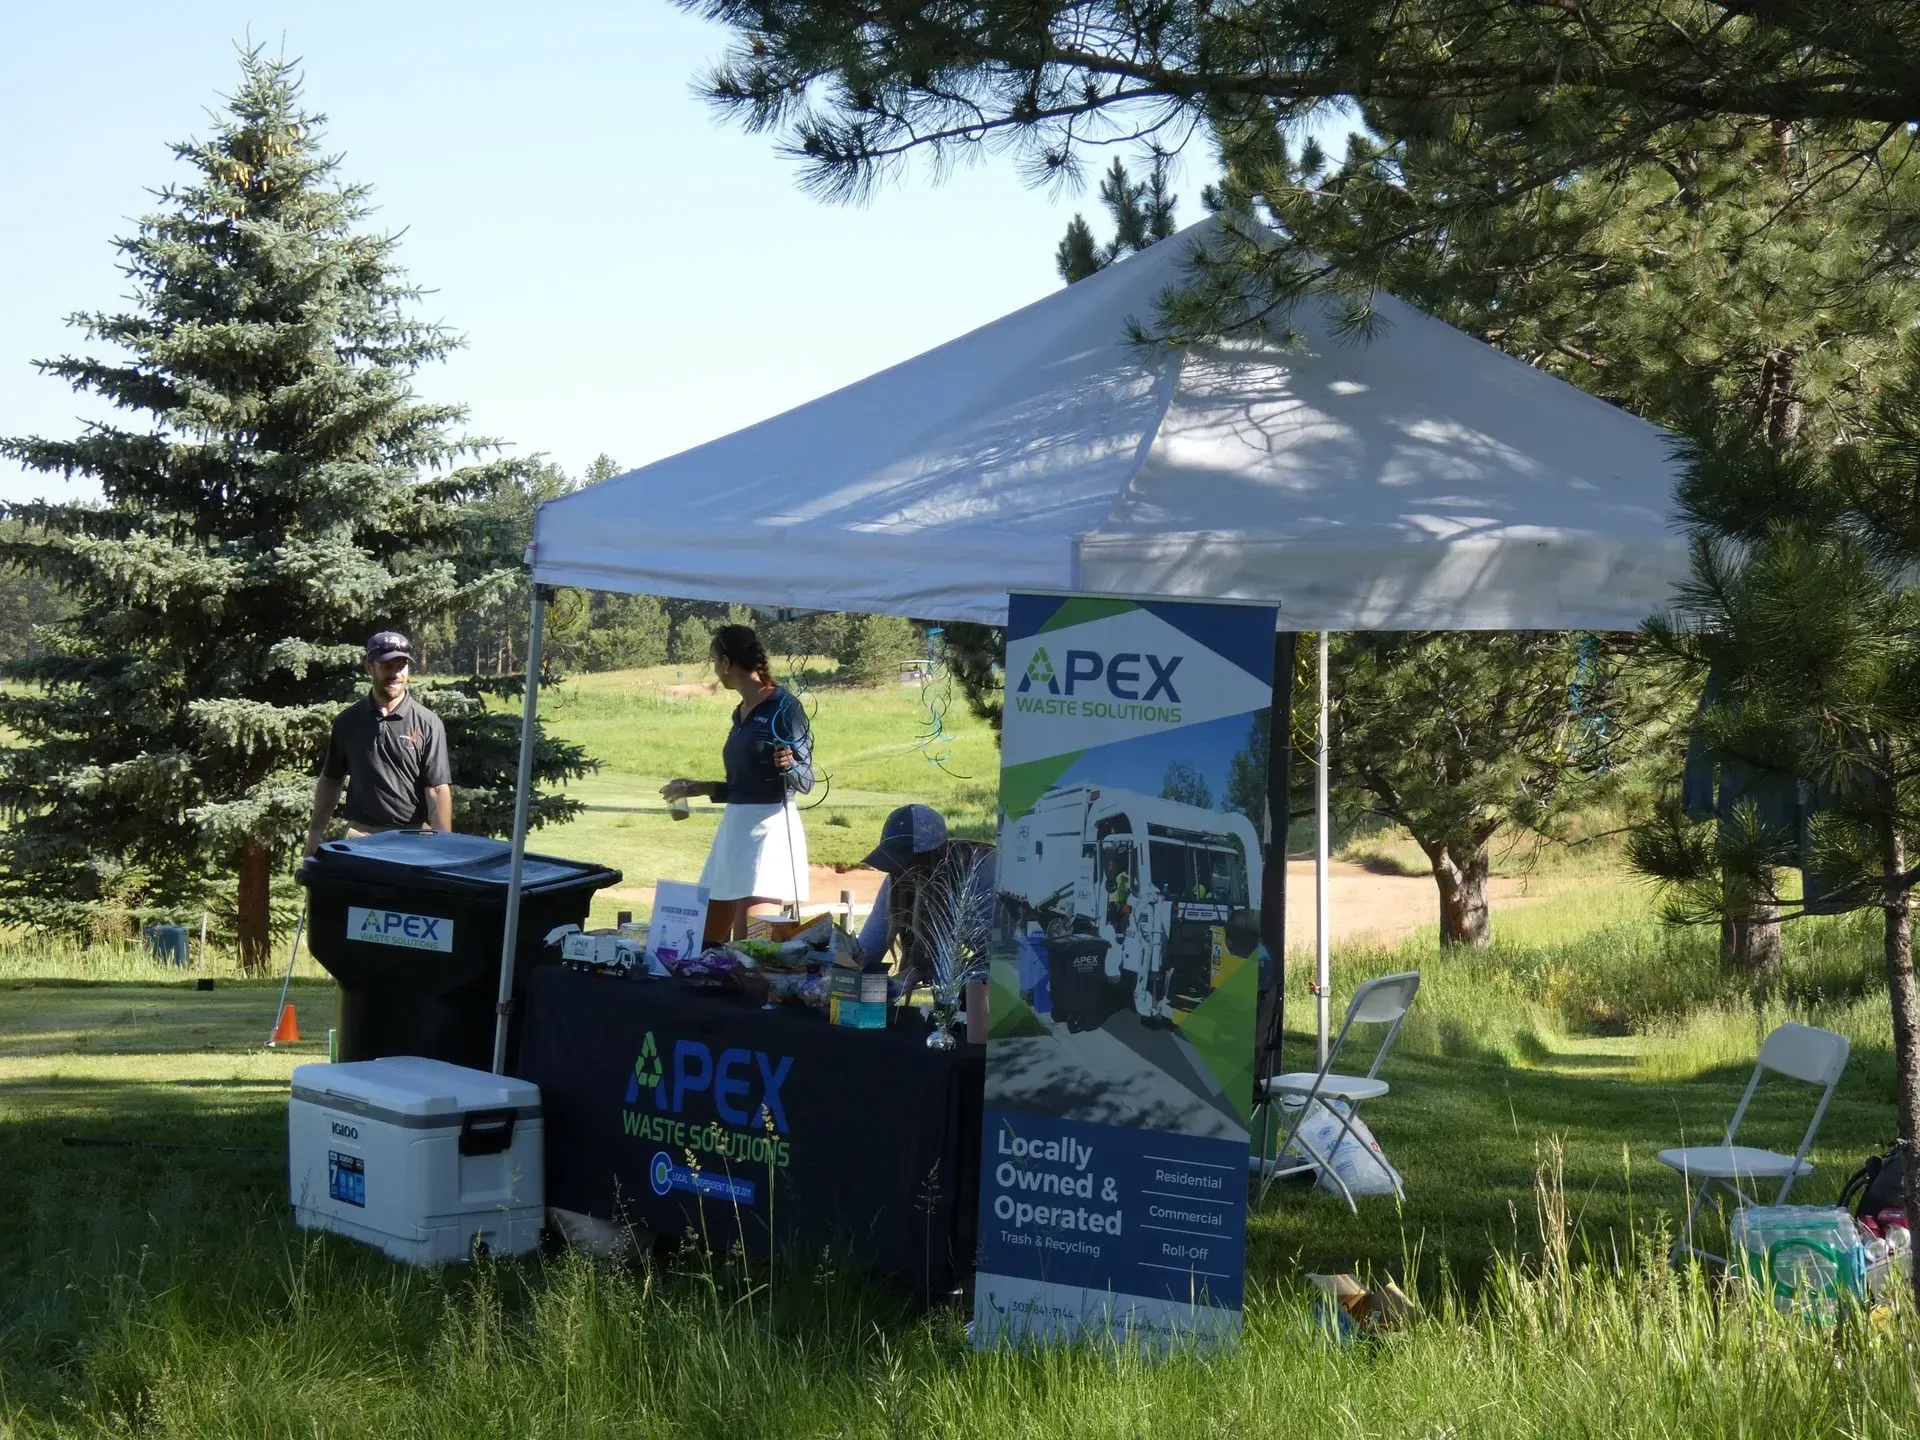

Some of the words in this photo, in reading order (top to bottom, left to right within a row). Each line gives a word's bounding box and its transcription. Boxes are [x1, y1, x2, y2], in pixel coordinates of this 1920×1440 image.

[1017, 646, 1184, 703] APEX
[1016, 697, 1076, 716] WASTE
[1083, 702, 1182, 723] SOLUTIONS
[360, 910, 440, 941] APEX
[360, 931, 390, 944] WASTE
[391, 936, 439, 950] SOLUTIONS
[1073, 955, 1098, 965] APEX
[625, 1031, 795, 1134] APEX
[332, 1121, 358, 1140] IGLOO
[623, 1109, 685, 1147] WASTE
[689, 1124, 790, 1168] SOLUTIONS
[998, 1129, 1093, 1171] Locally
[672, 1171, 688, 1184] LOCAL
[996, 1161, 1094, 1199] Owned
[1101, 1176, 1119, 1203] &
[1155, 1169, 1222, 1190] Residential
[994, 1195, 1122, 1236] Operated
[1149, 1204, 1222, 1226] Commercial
[1001, 1230, 1032, 1247] Trash
[1035, 1235, 1043, 1248] &
[1045, 1237, 1100, 1257] Recycling
[1162, 1243, 1208, 1261] Roll-Off
